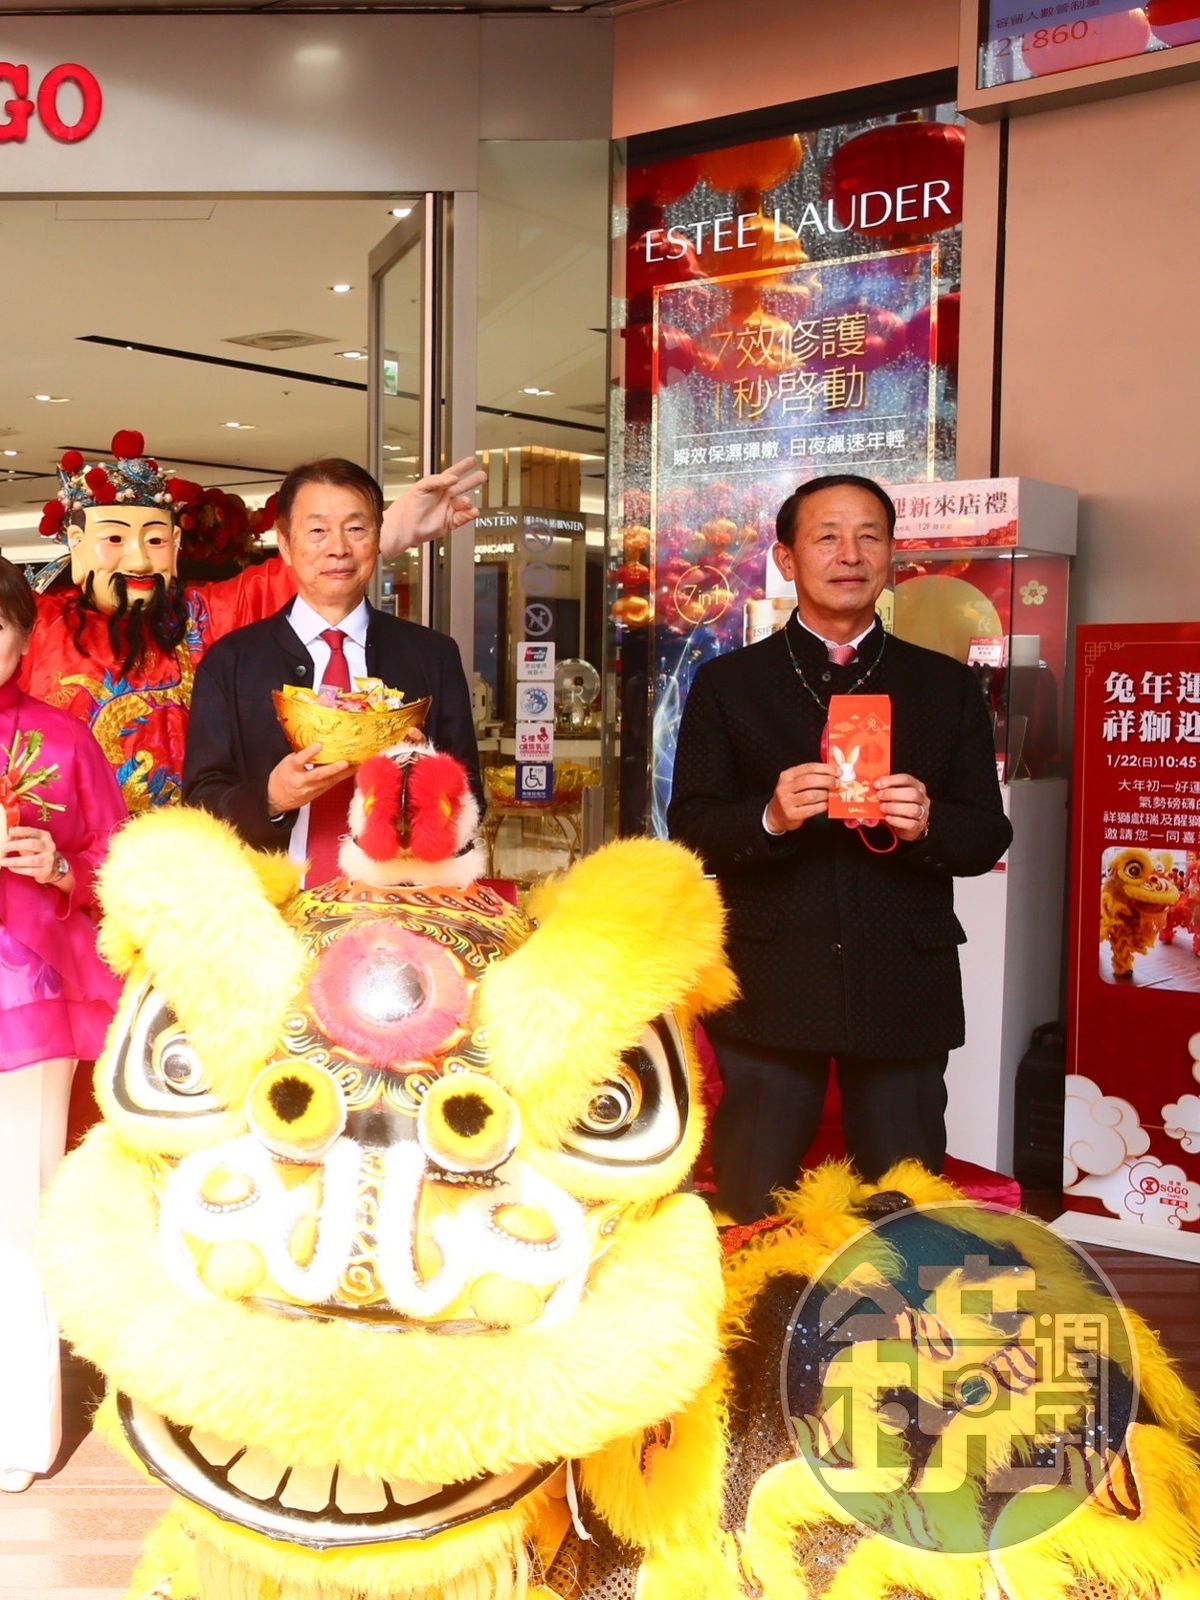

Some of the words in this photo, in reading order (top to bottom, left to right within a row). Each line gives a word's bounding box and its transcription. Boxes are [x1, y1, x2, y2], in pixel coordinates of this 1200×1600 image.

[774, 179, 952, 243] LAUDER
[1104, 827, 1200, 845] 邀請您一同喜
